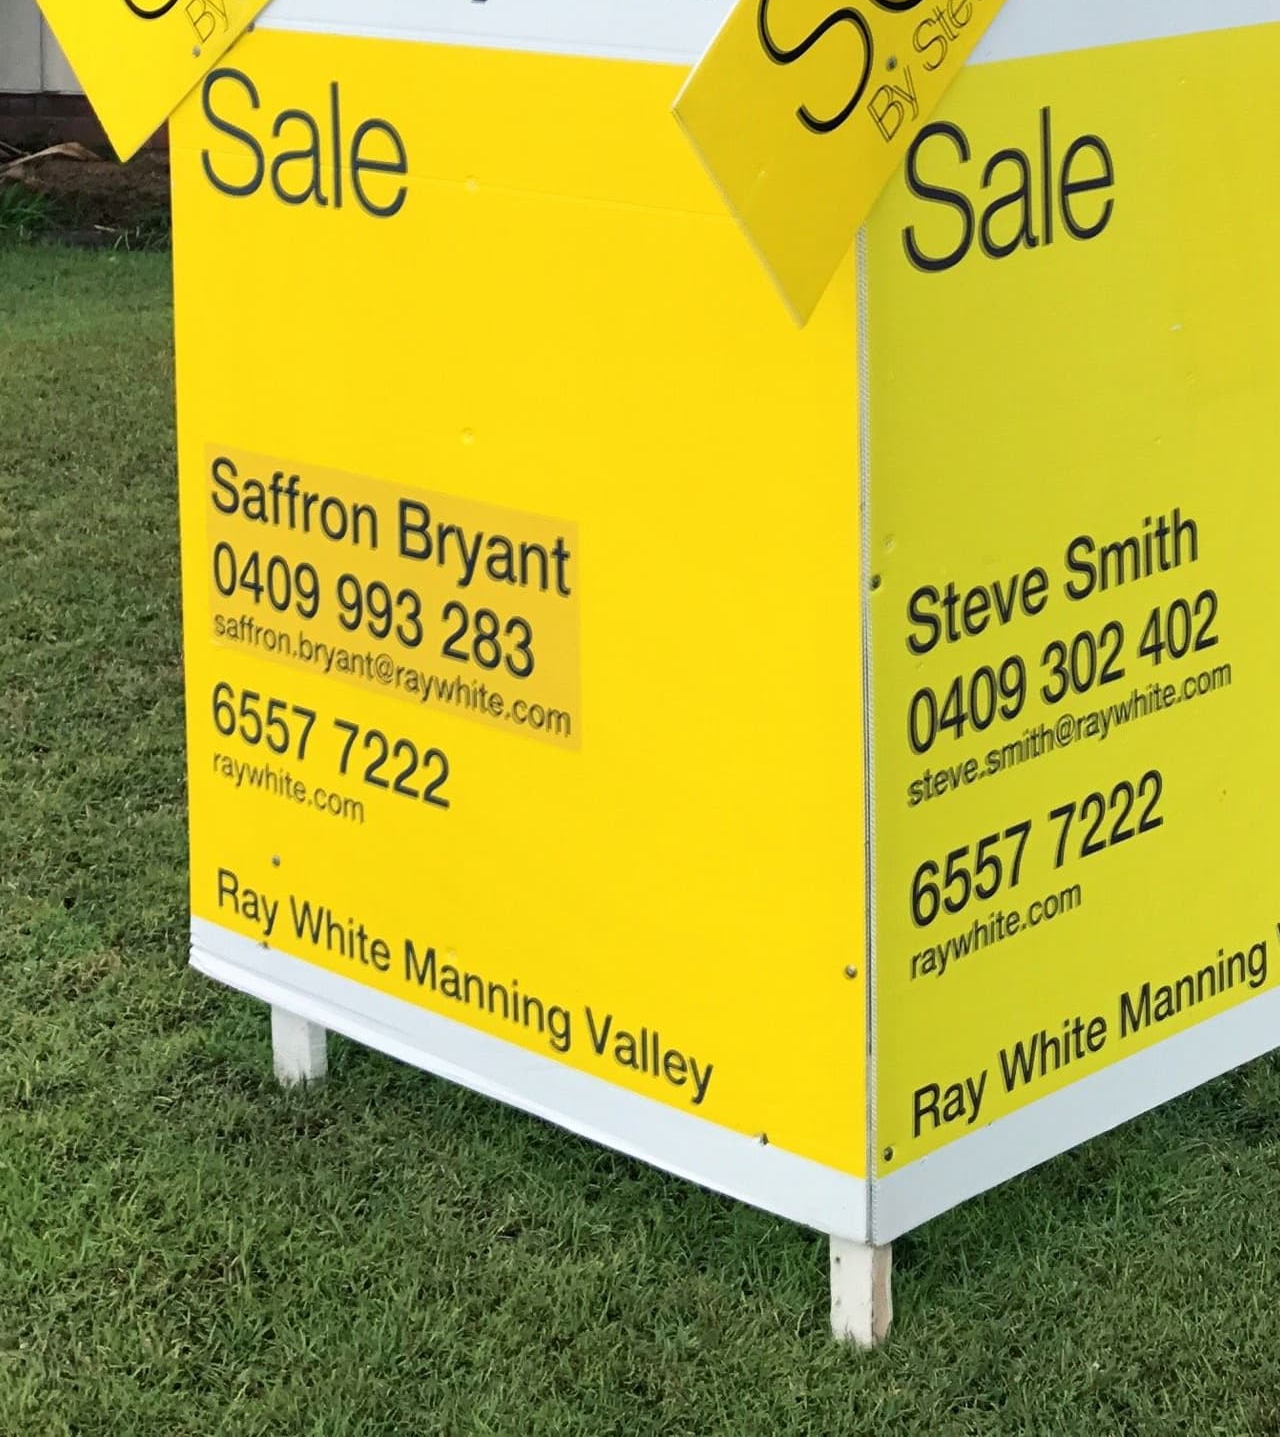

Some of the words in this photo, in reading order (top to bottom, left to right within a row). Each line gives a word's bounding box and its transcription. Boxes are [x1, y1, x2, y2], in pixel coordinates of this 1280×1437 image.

[201, 67, 409, 218] Sale
[867, 65, 919, 145] By
[901, 107, 1114, 273] Sale
[211, 456, 378, 551] Saffron
[397, 498, 572, 597] Bryant
[905, 566, 1049, 657] Steve
[1063, 507, 1199, 603] Smith
[212, 541, 320, 619] 0409
[336, 573, 423, 649] 993
[441, 601, 536, 679] 283
[213, 609, 572, 738] saffron.bryant@raywhite.com
[907, 657, 1026, 756] 0409
[1041, 621, 1124, 706] 302
[1139, 589, 1219, 665] 402
[211, 680, 316, 761] 6557
[332, 719, 450, 811] 7222
[213, 750, 365, 825] raywhite.com
[907, 660, 1233, 808] steve.smith@raywhite.com
[910, 820, 1033, 930] 6557
[1048, 769, 1164, 869] 7222
[217, 867, 280, 937] Ray
[289, 895, 391, 971] White
[404, 939, 572, 1053] Manning
[585, 1005, 714, 1105] Valley
[910, 881, 1082, 982] raywhite.com
[912, 1067, 988, 1139] Ray
[1000, 1014, 1107, 1094] White
[1121, 939, 1267, 1046] Manning
